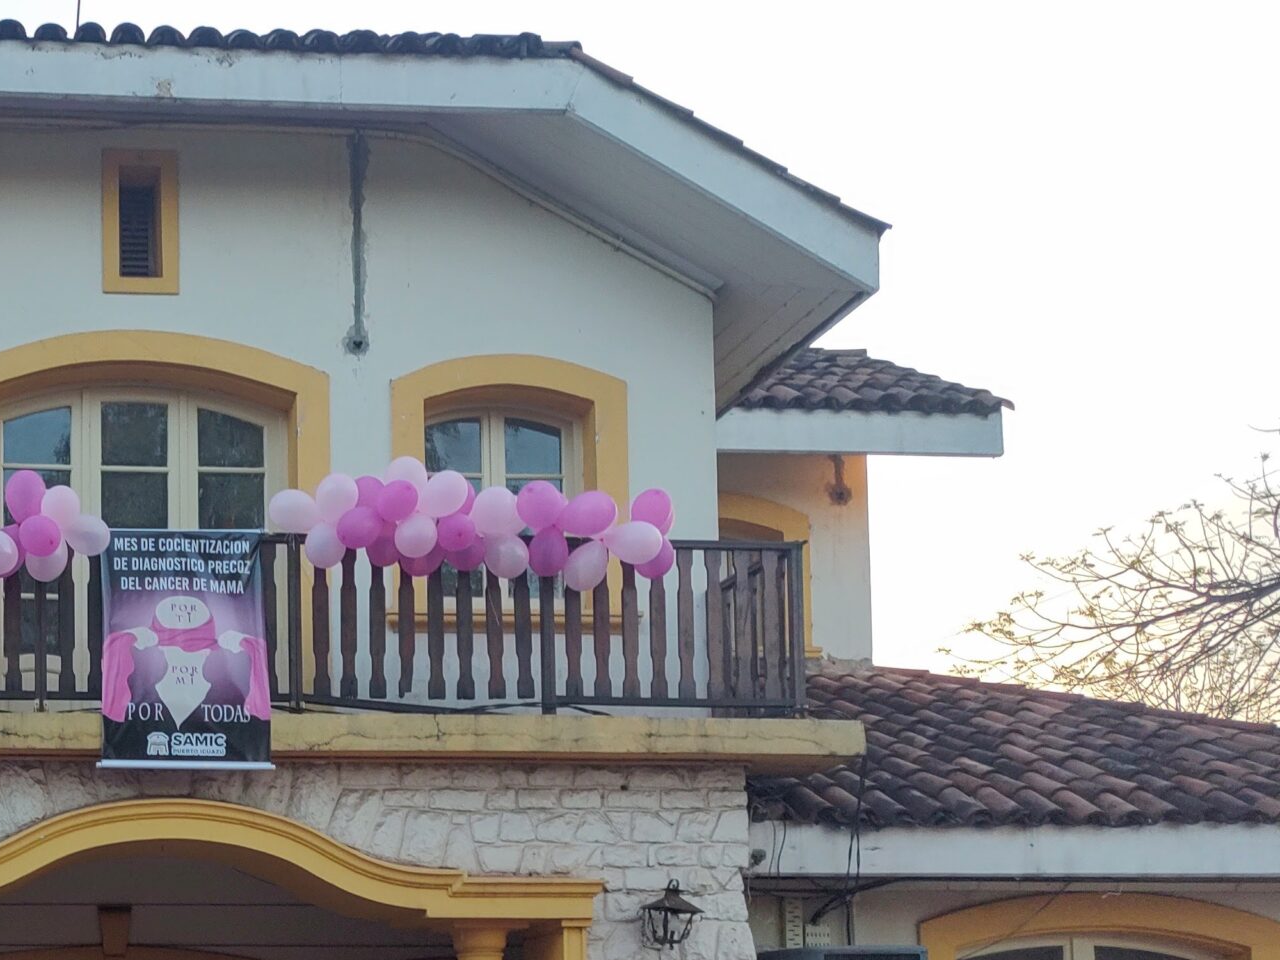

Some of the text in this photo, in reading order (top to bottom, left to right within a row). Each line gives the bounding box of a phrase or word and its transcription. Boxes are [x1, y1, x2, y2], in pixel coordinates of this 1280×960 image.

[114, 538, 250, 554] MES DE COCIENTIZACION
[114, 557, 251, 574] DE DIAGNOSTICO PRECOZ
[121, 577, 245, 594] DEL CANCER DE MAMA
[171, 603, 197, 612] POR
[172, 665, 199, 674] POR
[128, 702, 251, 722] POR TODAS
[173, 734, 224, 747] SAMIC
